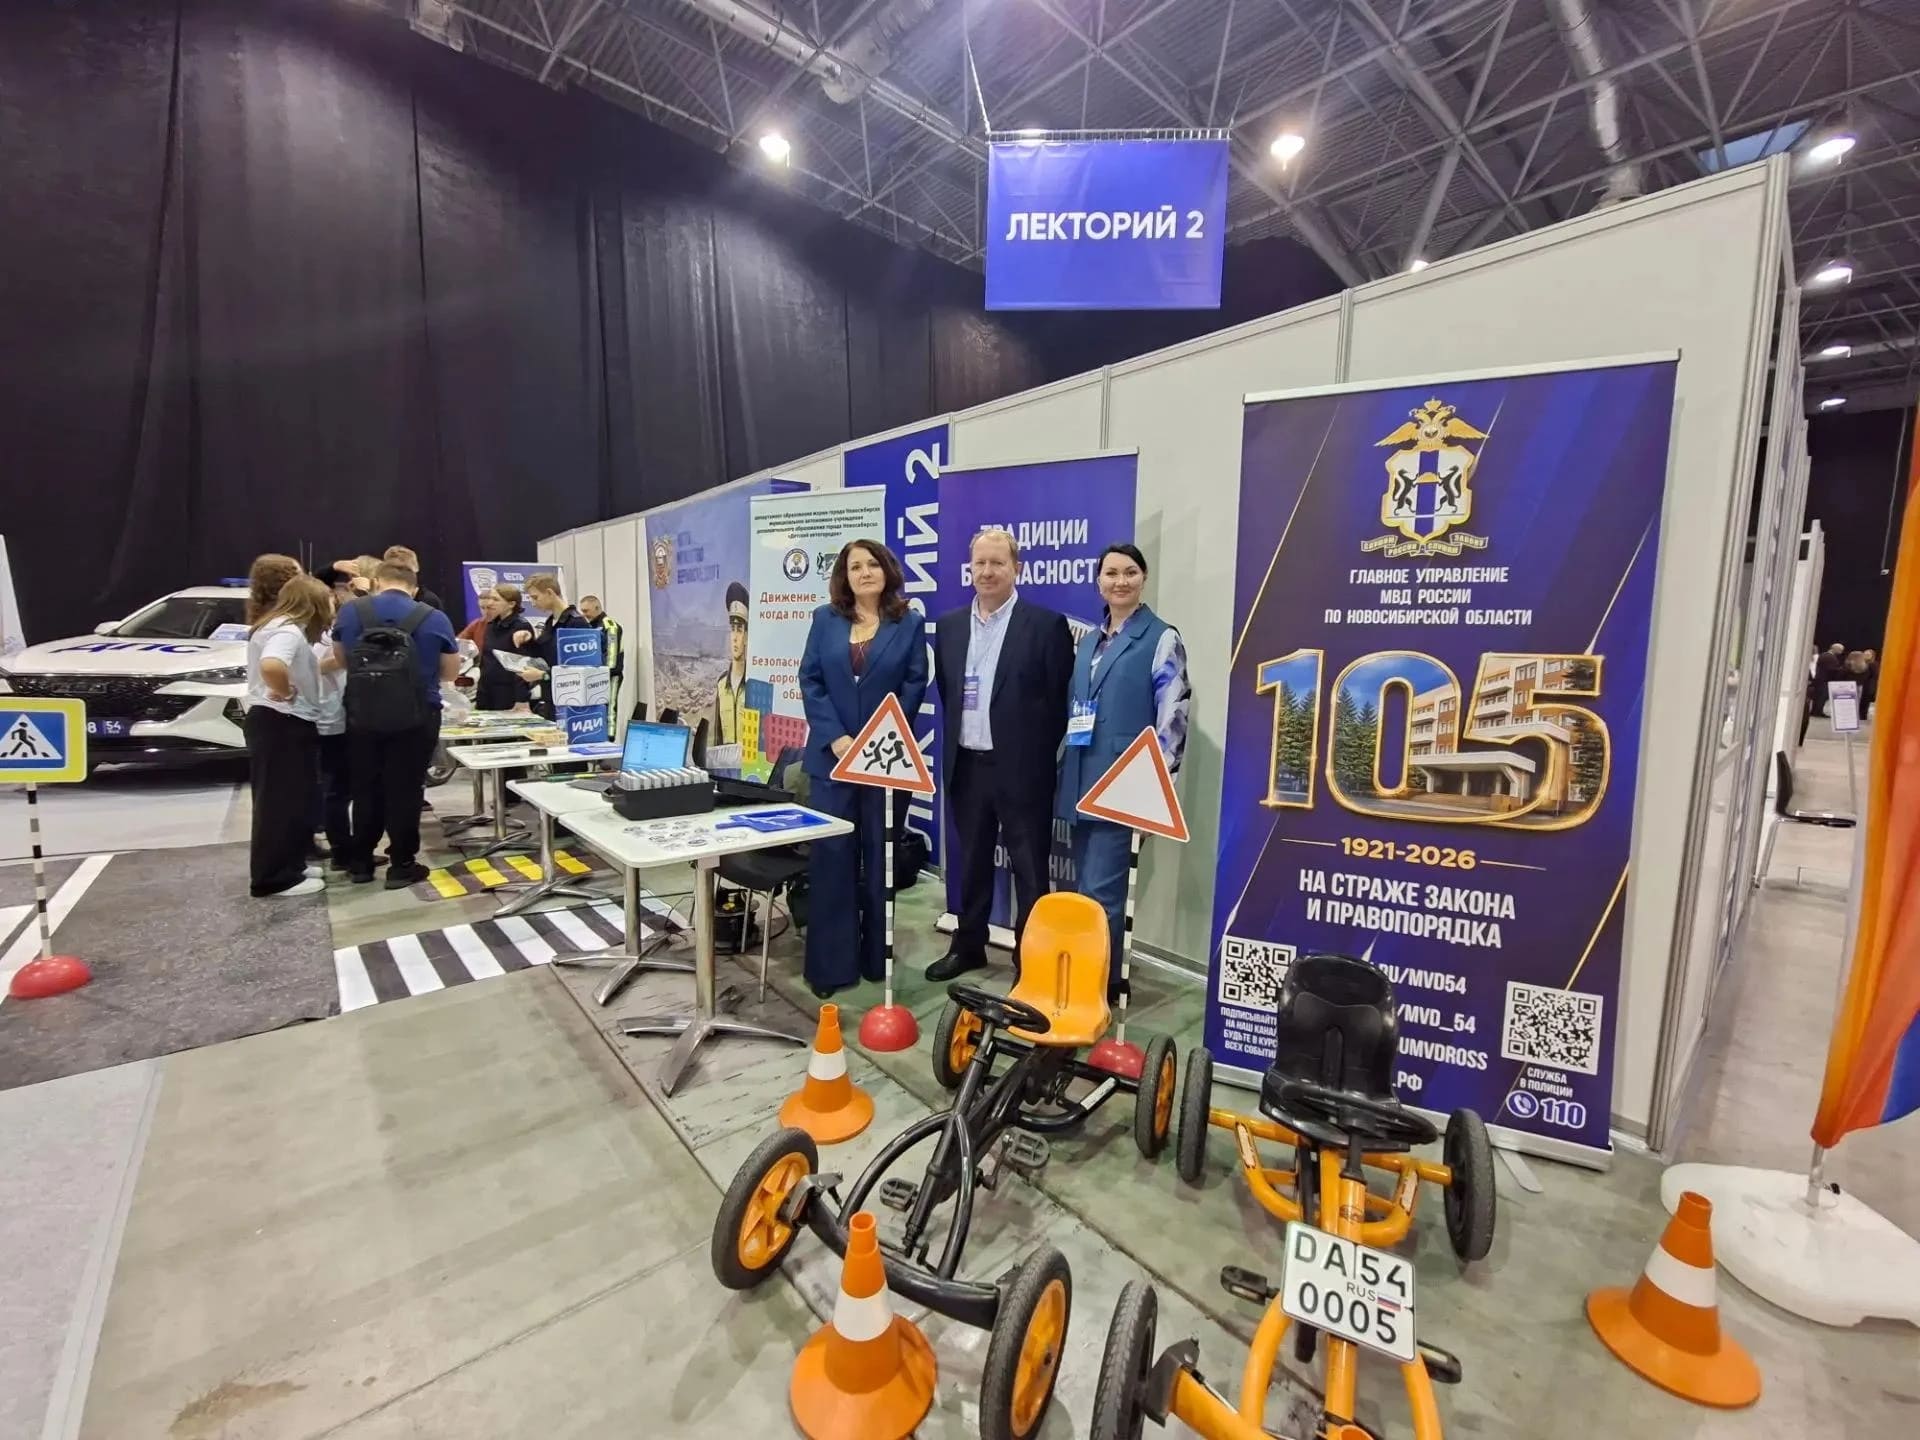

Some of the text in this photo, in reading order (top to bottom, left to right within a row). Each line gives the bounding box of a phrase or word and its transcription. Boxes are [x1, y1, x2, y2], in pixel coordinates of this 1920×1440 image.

[1006, 205, 1205, 240] ЛЕКТОРИЙ 2
[905, 442, 940, 485] 2
[980, 519, 1088, 551] АДИЦИИ
[1350, 567, 1509, 584] ГЛАВНОЕ УПРАВЛЕНИЕ
[760, 592, 817, 604] Движение
[1380, 588, 1472, 605] МВД РОССИИ
[760, 610, 788, 620] когда
[792, 610, 805, 619] по
[1324, 608, 1532, 626] ПО НОВОСИБИРСКОЙ ОБЛАСТИ
[48, 642, 211, 654] ДПС
[563, 638, 598, 653] СТОЙ
[752, 656, 800, 667] Безопасн
[556, 680, 580, 688] СМОТРИ
[571, 718, 603, 733] ИДИ
[1256, 648, 1611, 830] 105
[1341, 837, 1476, 870] 1921-2026
[1299, 868, 1516, 920] НА СТРАЖЕ ЗАКОНА
[1306, 897, 1502, 948] И ПРАВОПОРЯДКА
[1225, 1018, 1235, 1029] НА
[1236, 1020, 1253, 1033] НАШ
[1223, 1028, 1251, 1044] БУДЬТЕ
[1252, 1034, 1258, 1044] В
[1224, 1039, 1243, 1052] ВСЕХ
[1397, 1036, 1488, 1071] UMVDROSS
[1527, 1066, 1568, 1085] СЛУЖБА
[1519, 1077, 1574, 1098] В ПОЛИЦИИ
[1540, 1097, 1587, 1129] 110
[1295, 1230, 1406, 1298] DA 54
[1346, 1281, 1376, 1302] RUS
[1299, 1281, 1397, 1345] 0005
